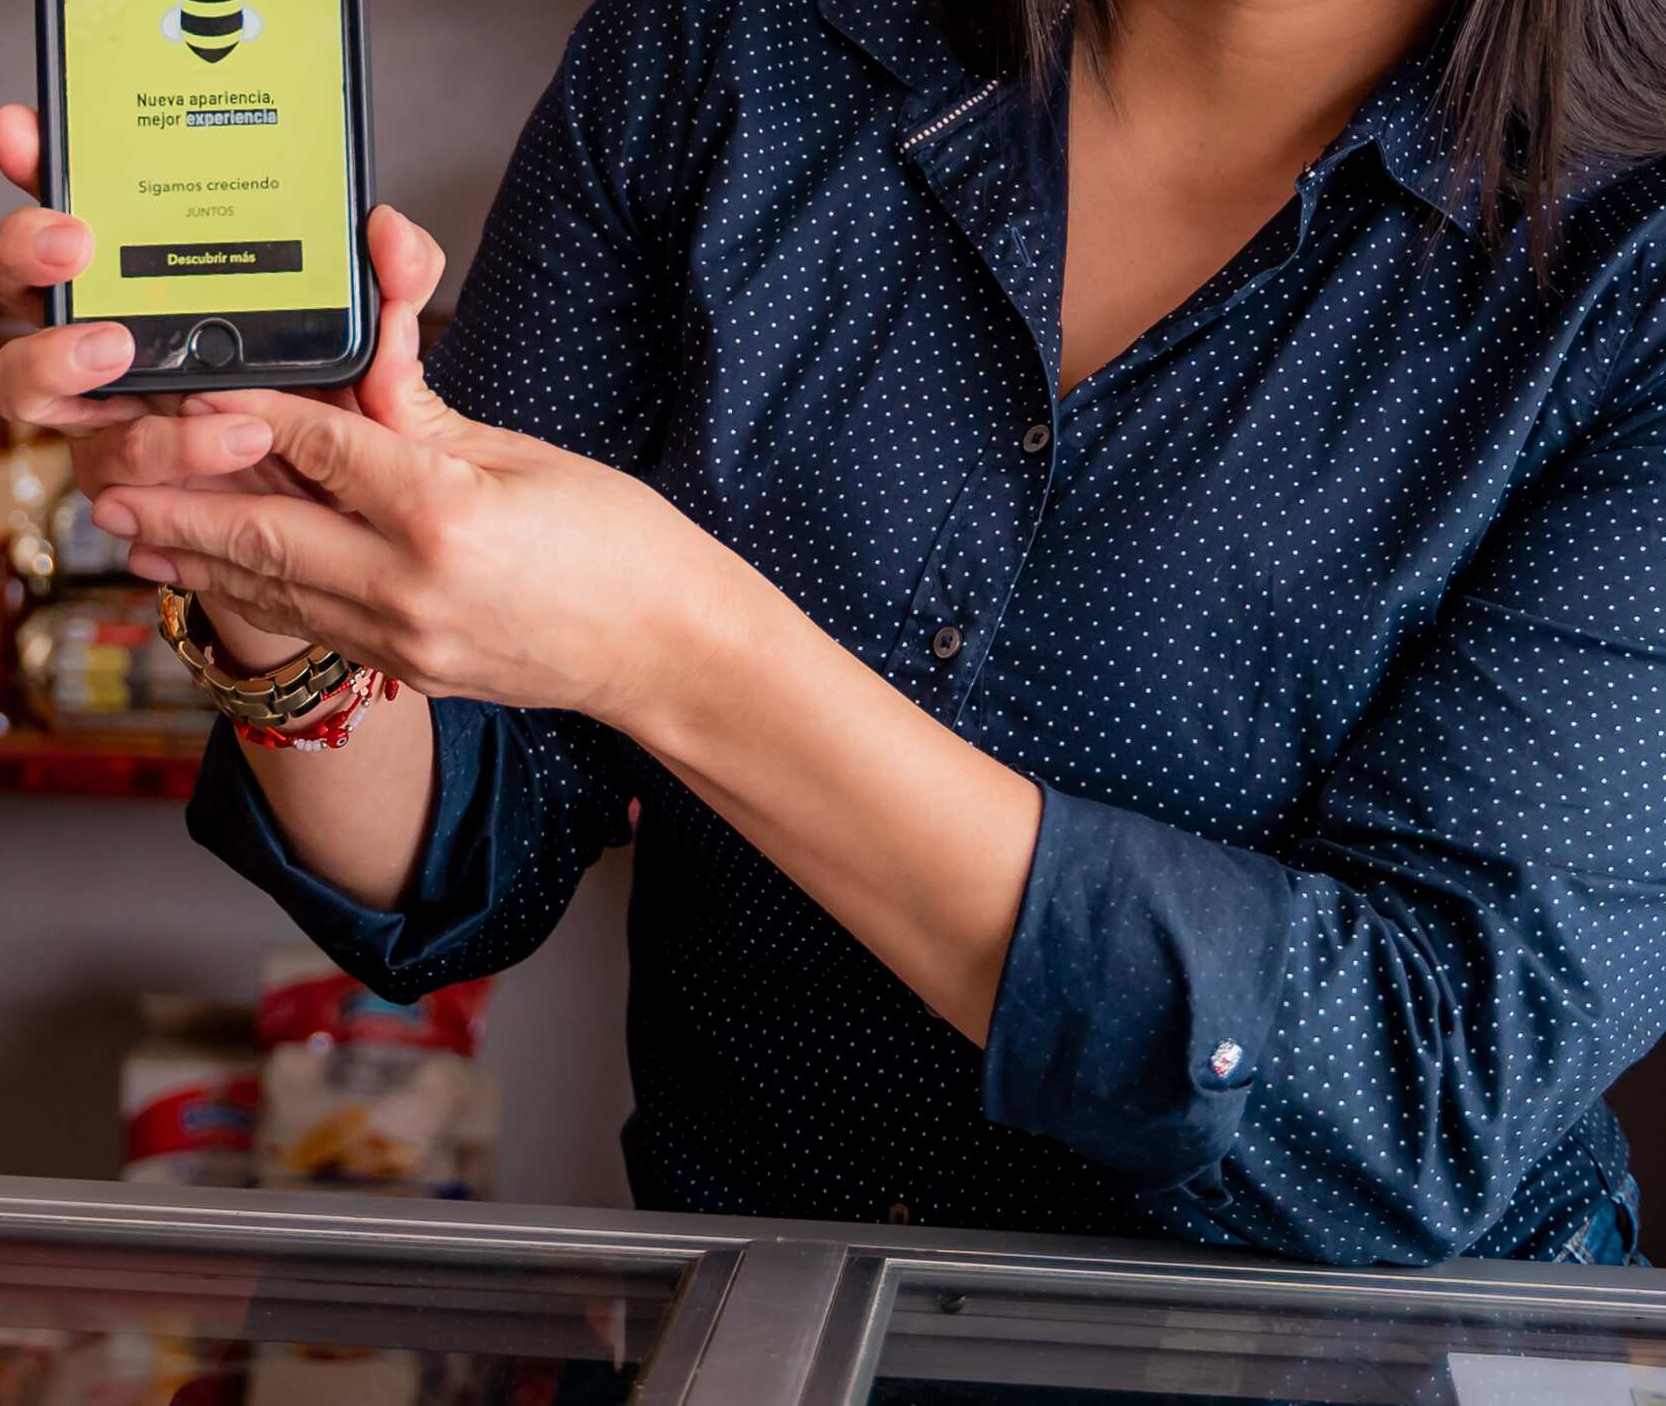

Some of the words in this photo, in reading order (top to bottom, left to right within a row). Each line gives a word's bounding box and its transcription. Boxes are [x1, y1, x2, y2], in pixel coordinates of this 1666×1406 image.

[136, 93, 184, 107] Nueva
[189, 91, 275, 107] apariencia,
[136, 112, 182, 130] mejor
[186, 109, 277, 127] experiencia
[138, 179, 202, 196] Sigamos
[206, 176, 279, 192] creciendo
[186, 206, 234, 218] JUNTOS
[167, 253, 228, 267] Descubrir
[230, 251, 256, 265] más
